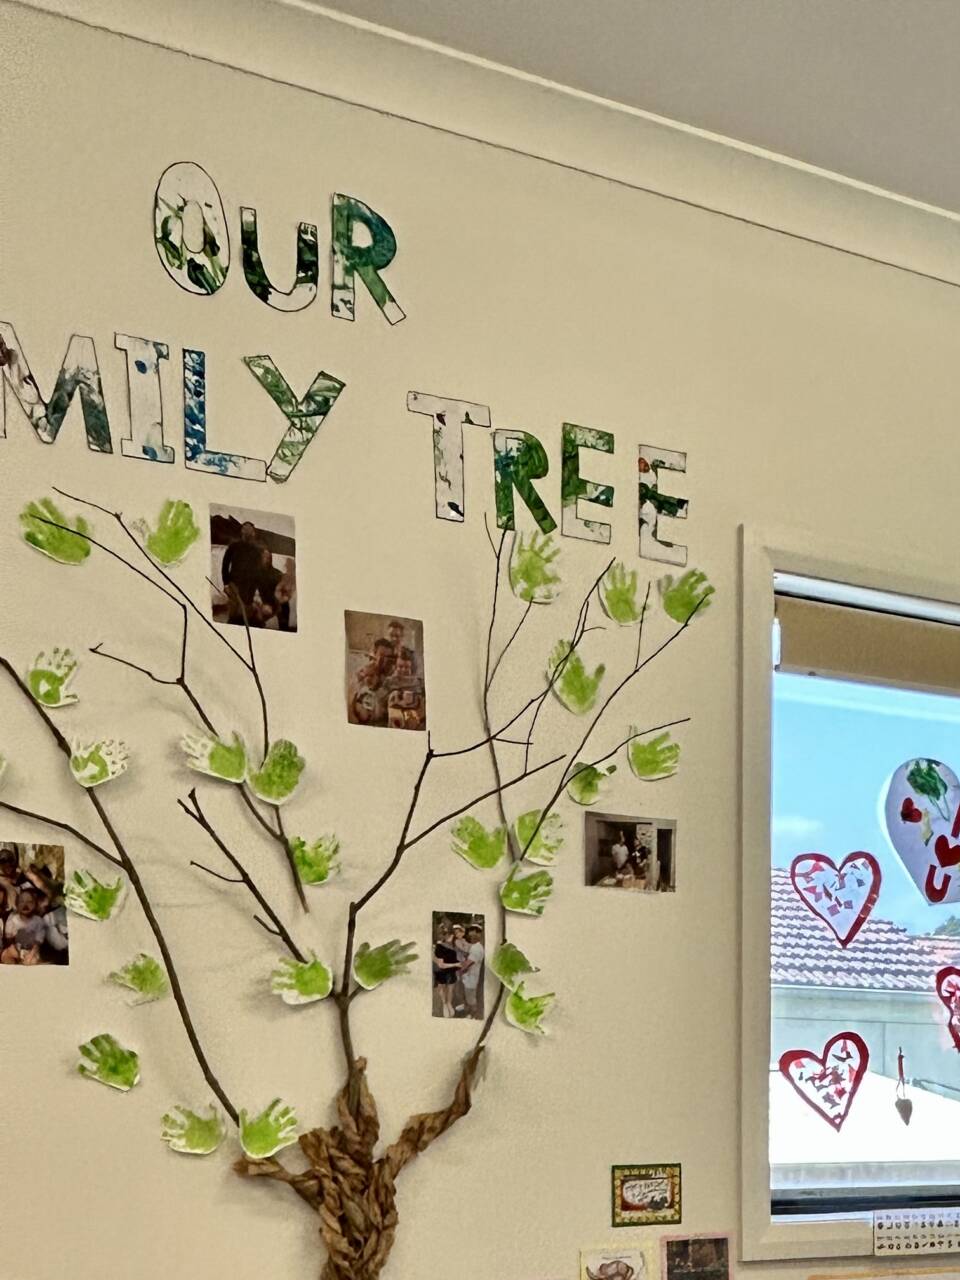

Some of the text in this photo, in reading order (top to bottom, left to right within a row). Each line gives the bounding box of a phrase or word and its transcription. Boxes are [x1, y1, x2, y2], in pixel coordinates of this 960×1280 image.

[153, 160, 406, 325] OUR
[406, 390, 689, 567] TREE
[925, 864, 952, 903] U
